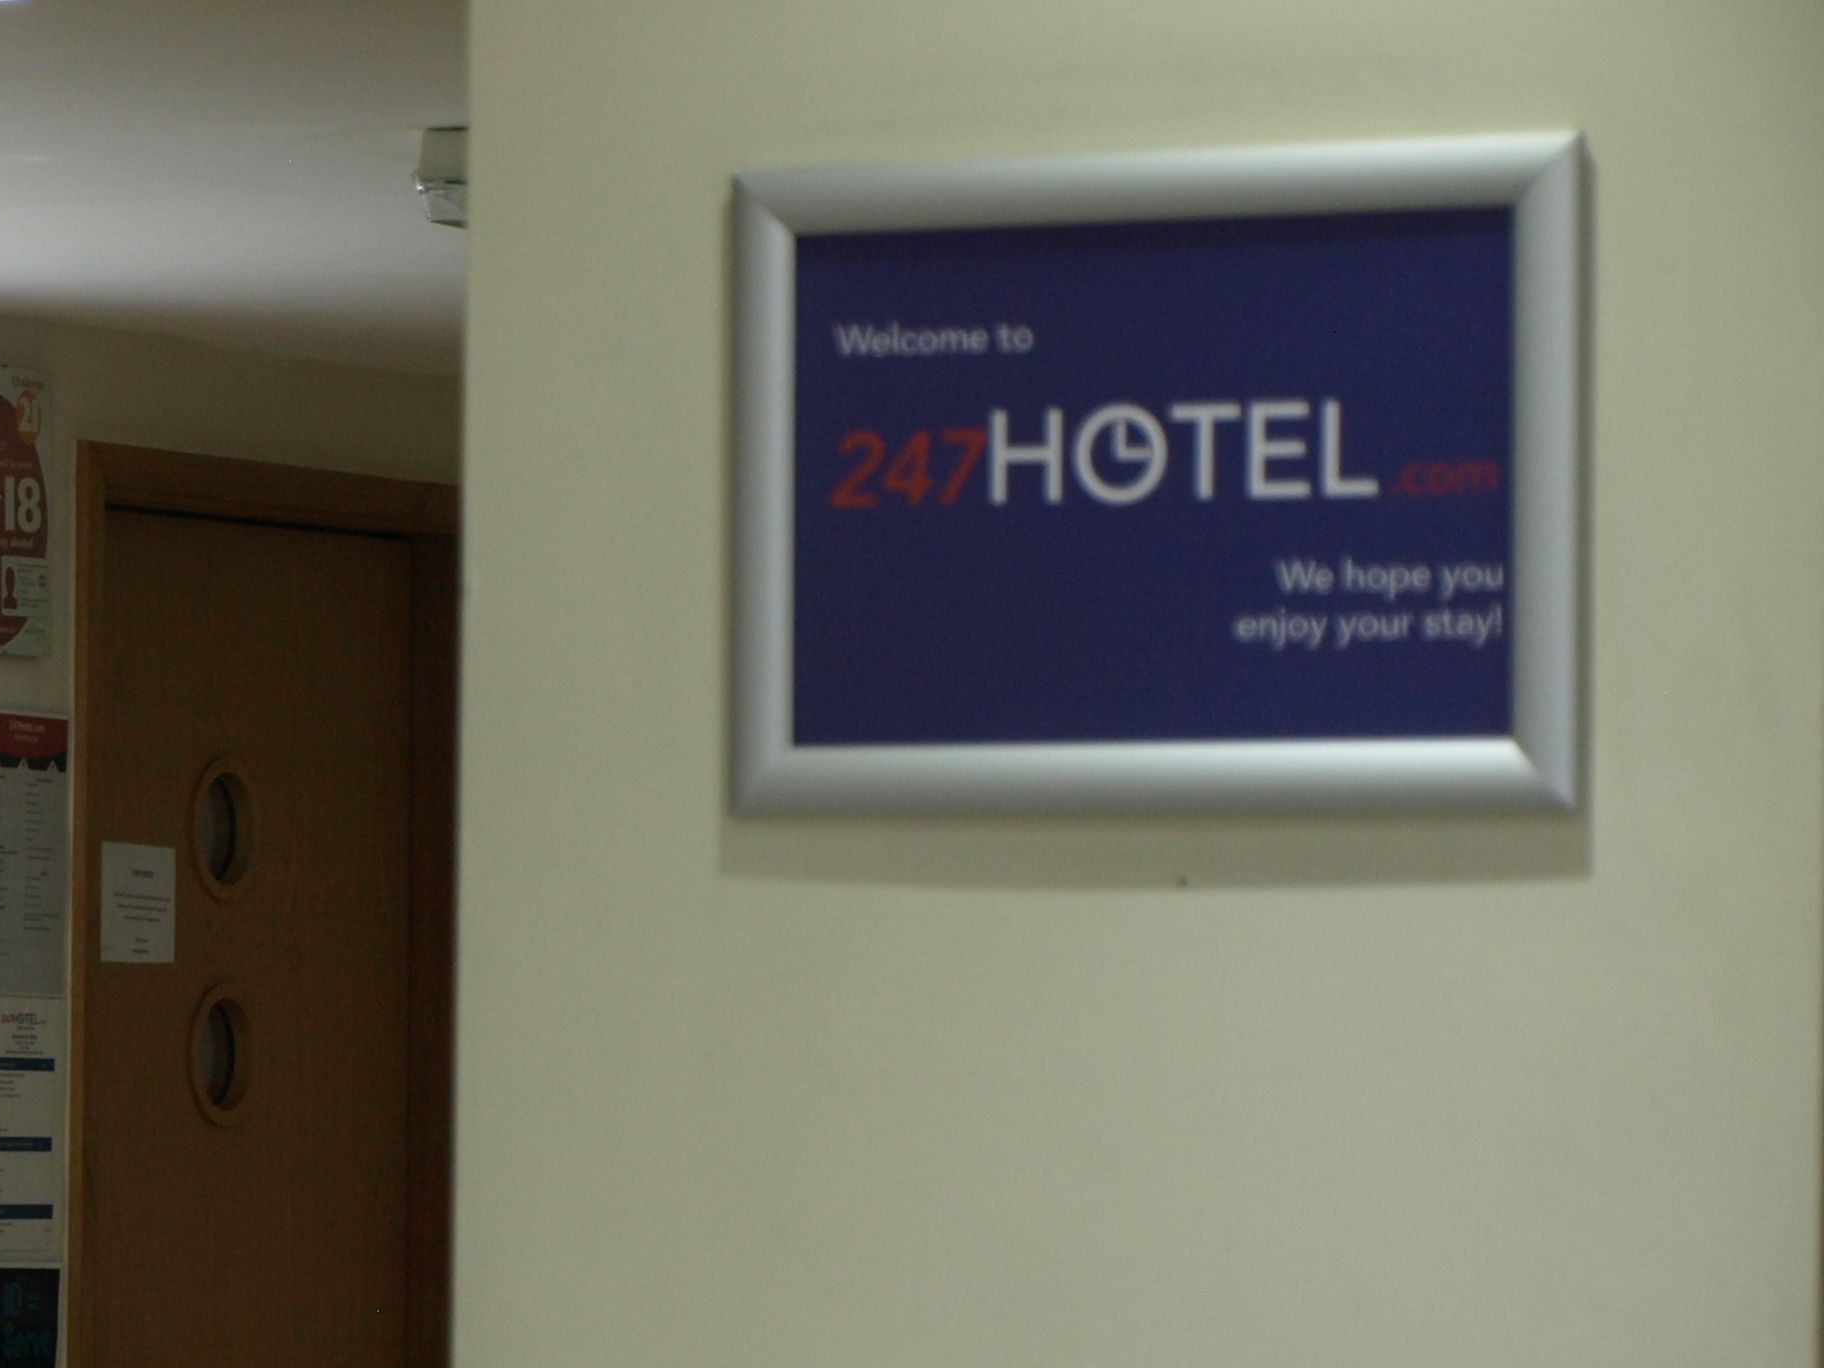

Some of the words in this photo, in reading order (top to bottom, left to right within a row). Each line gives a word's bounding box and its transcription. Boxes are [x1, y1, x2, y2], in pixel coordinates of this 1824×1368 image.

[834, 322, 988, 359] Welcome
[996, 322, 1035, 356] to
[4, 474, 42, 534] 18
[1278, 557, 1336, 595] We
[1342, 553, 1432, 602] hope
[1441, 563, 1505, 600] you
[1234, 606, 1329, 650] enjoy
[1337, 611, 1413, 650] your
[1422, 602, 1504, 648] stay!
